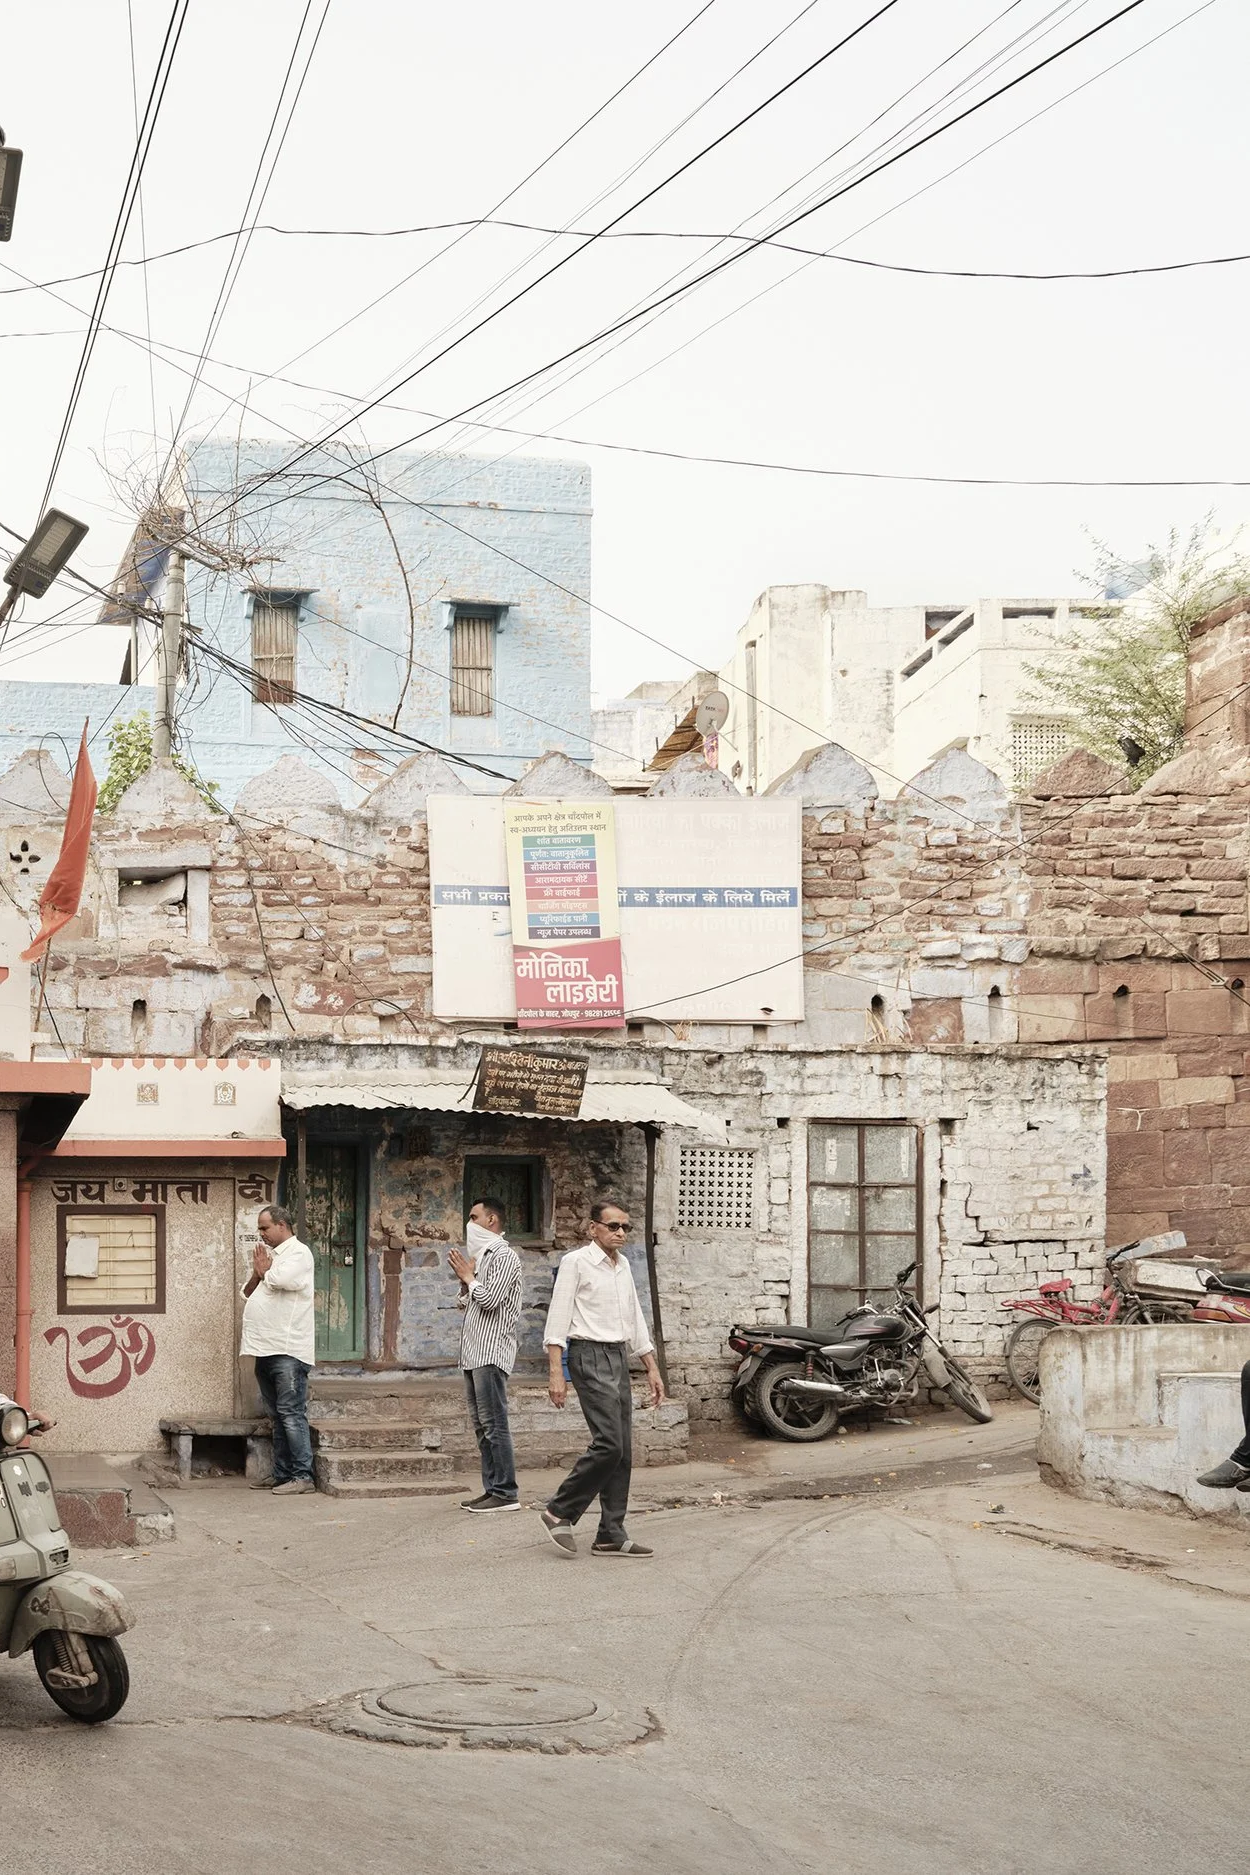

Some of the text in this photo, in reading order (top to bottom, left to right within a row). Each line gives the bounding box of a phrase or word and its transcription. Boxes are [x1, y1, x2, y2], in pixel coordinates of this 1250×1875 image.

[514, 813, 534, 822] आपके
[537, 813, 552, 821] अपने
[554, 812, 566, 821] क्षेत्र
[548, 824, 558, 834] हेतु
[441, 889, 472, 902] सभी
[478, 893, 510, 903] प्रका
[633, 890, 649, 903] के
[655, 889, 696, 905] ईलाज
[702, 890, 718, 903] के
[724, 889, 754, 903] लिये
[760, 889, 790, 903] मिलें
[553, 928, 566, 936] पेपर
[514, 951, 589, 979] मोनिका
[544, 974, 619, 1005] लाइब्रेरी
[51, 1173, 274, 1205] जय माता दी
